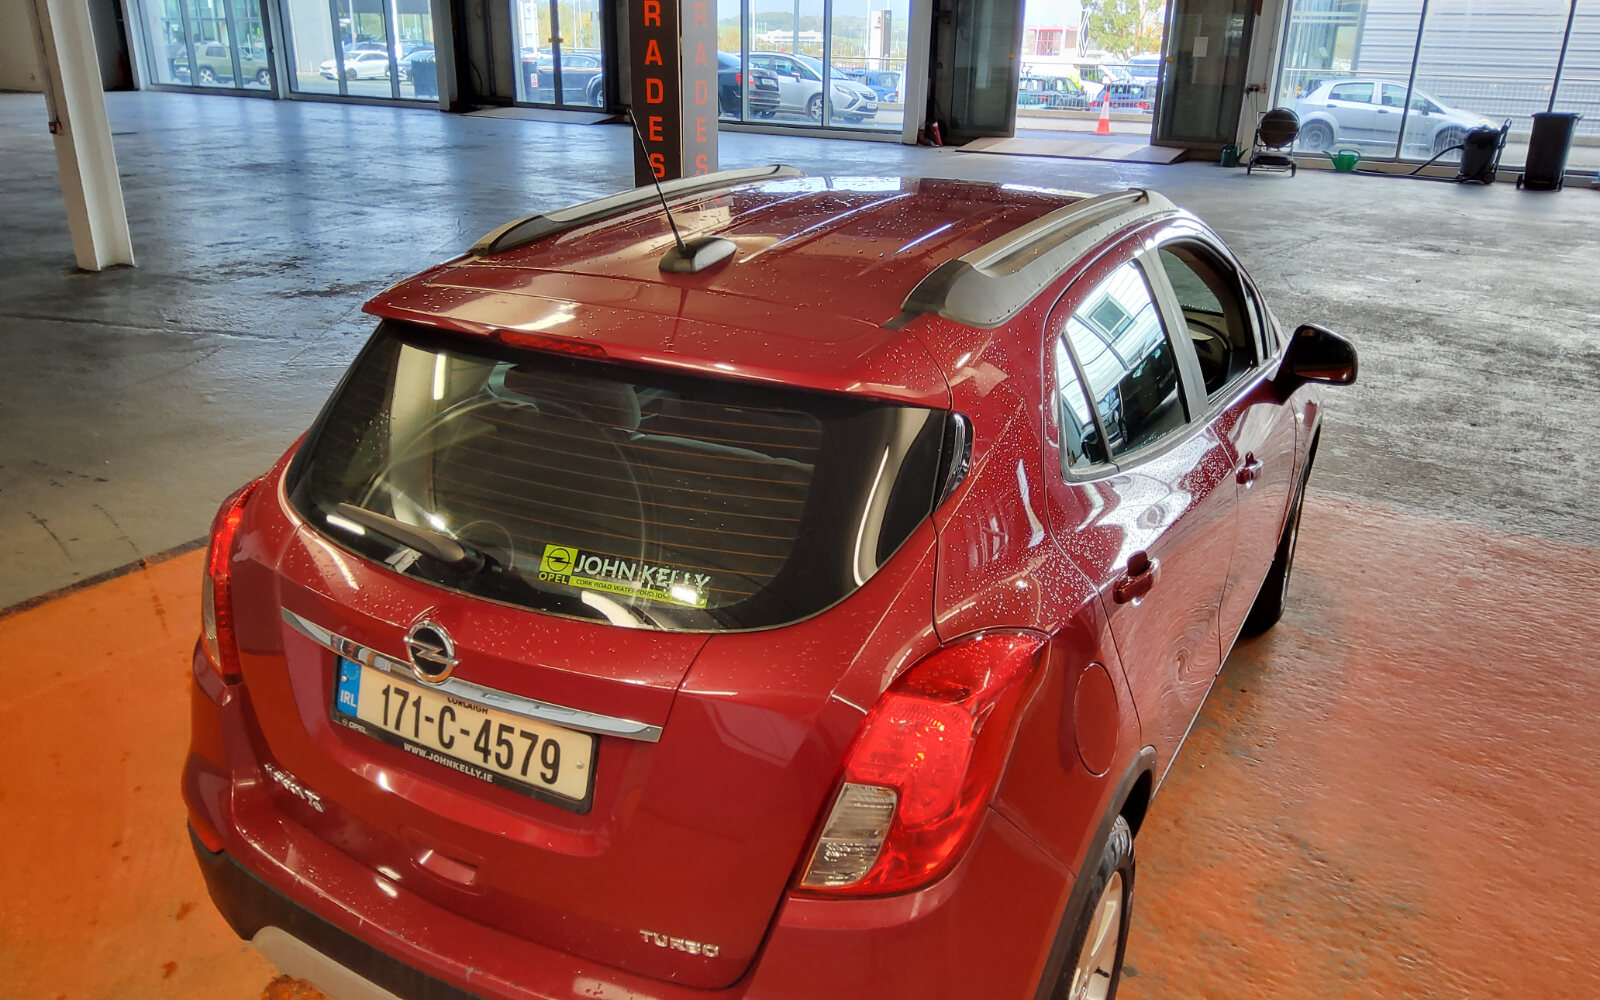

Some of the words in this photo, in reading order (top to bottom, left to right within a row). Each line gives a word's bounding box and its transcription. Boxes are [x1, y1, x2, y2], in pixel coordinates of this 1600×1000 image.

[538, 571, 568, 585] OPEL
[573, 554, 637, 582] JOHN
[576, 578, 593, 587] CORK
[594, 581, 612, 590] ROAD
[613, 585, 654, 597] WATEFORD
[340, 689, 357, 708] IRL
[381, 683, 562, 785] 171-C-4579
[403, 742, 494, 783] WWW.JOHNKELLY.IE
[639, 929, 719, 958] TURBO
